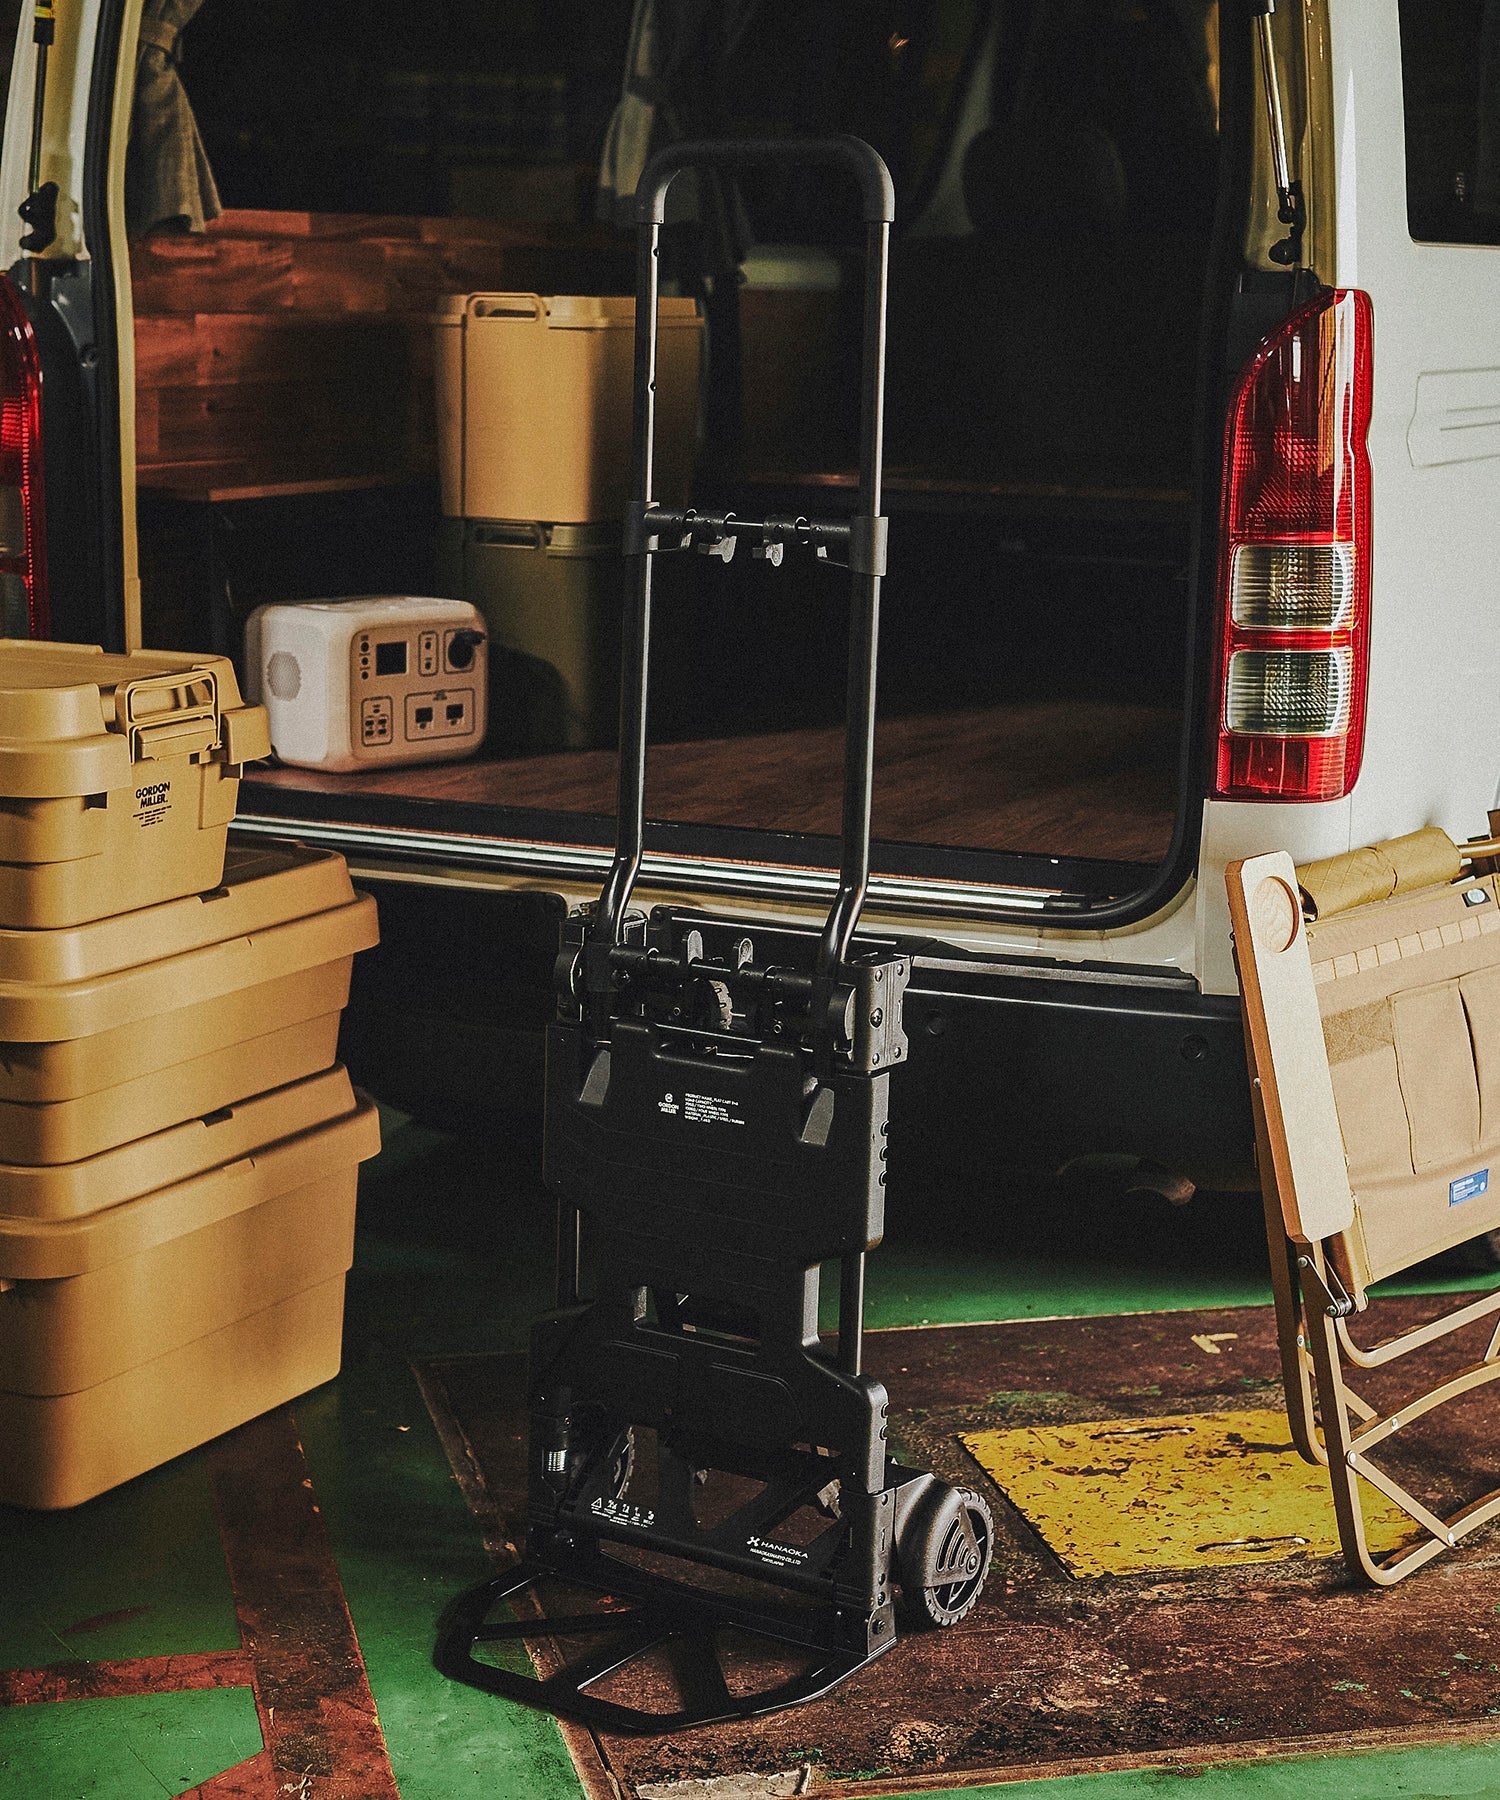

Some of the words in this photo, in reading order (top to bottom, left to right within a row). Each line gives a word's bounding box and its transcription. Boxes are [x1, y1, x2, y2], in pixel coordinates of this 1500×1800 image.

[136, 782, 170, 798] GORDON
[658, 1102, 679, 1110] GORDON
[761, 1541, 808, 1559] HANAOKA
